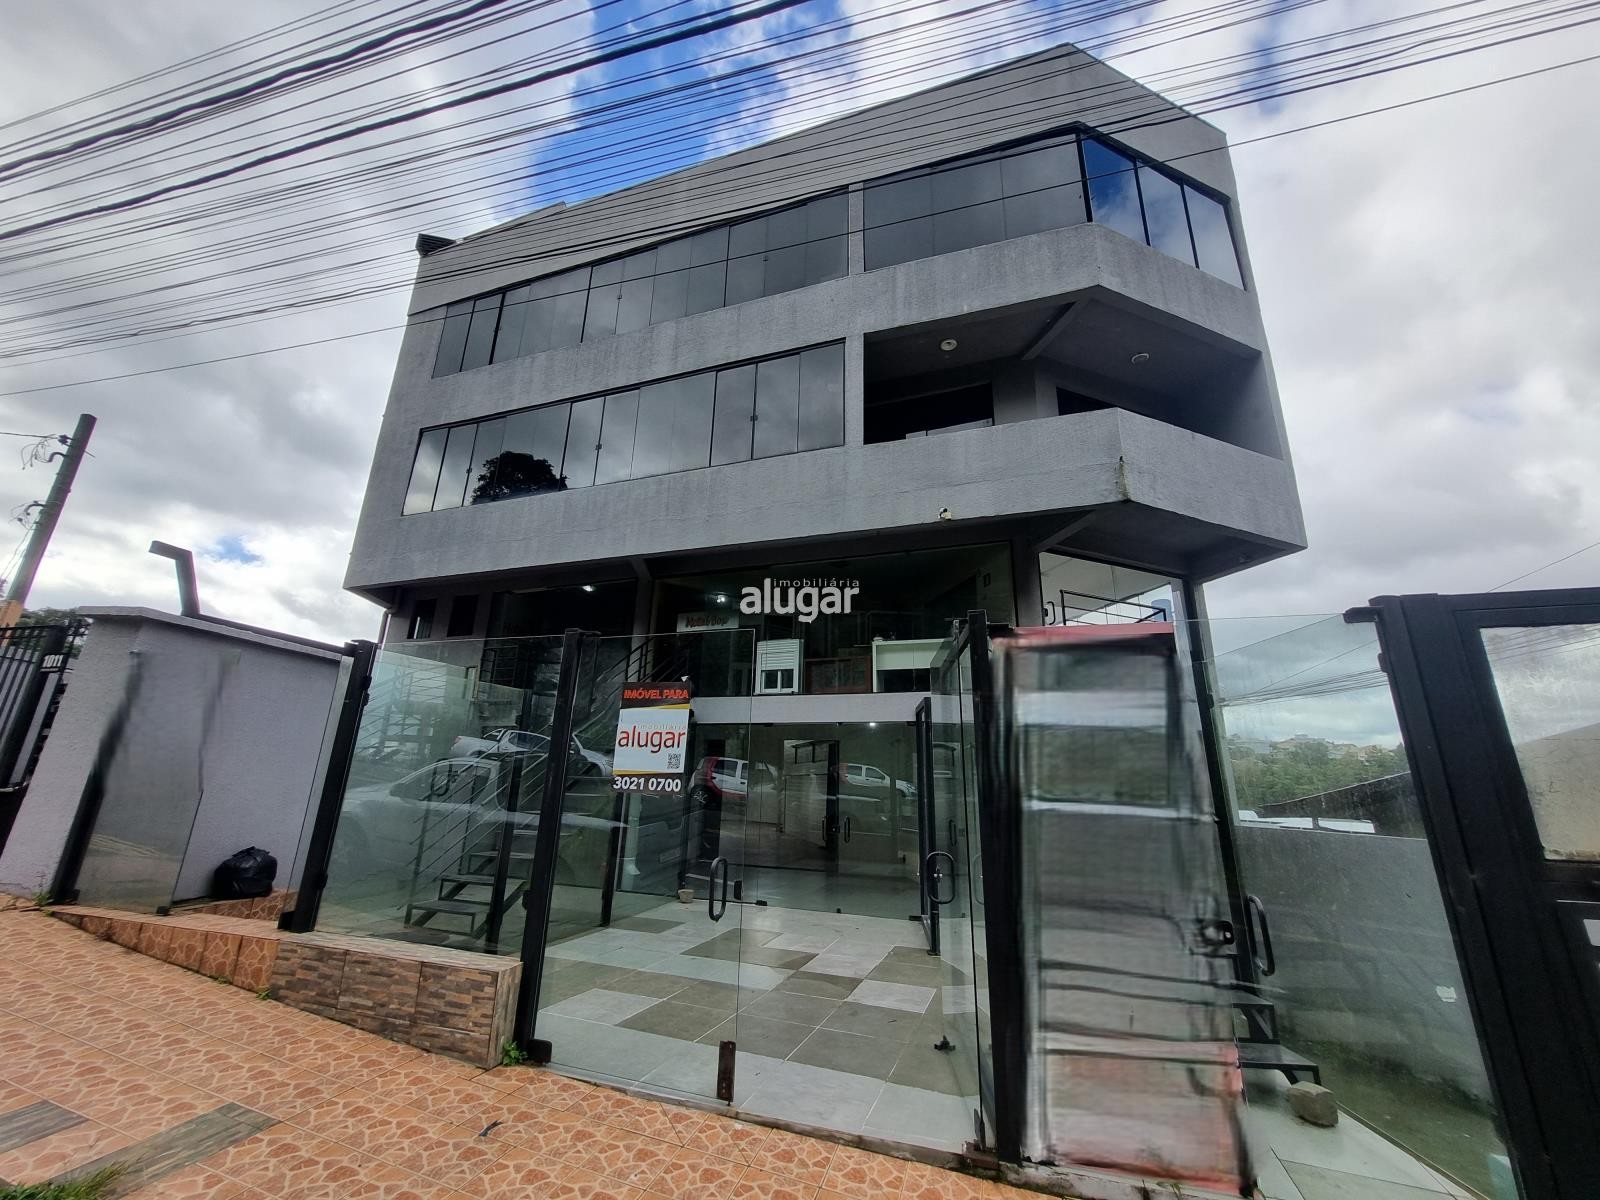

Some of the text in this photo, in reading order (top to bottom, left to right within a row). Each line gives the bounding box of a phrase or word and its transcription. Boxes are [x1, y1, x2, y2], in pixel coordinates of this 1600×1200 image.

[43, 655, 63, 667] 1011
[623, 688, 689, 699] IMÓVEL PARA
[618, 725, 686, 753] alugar
[613, 776, 681, 792] 3021 0700
